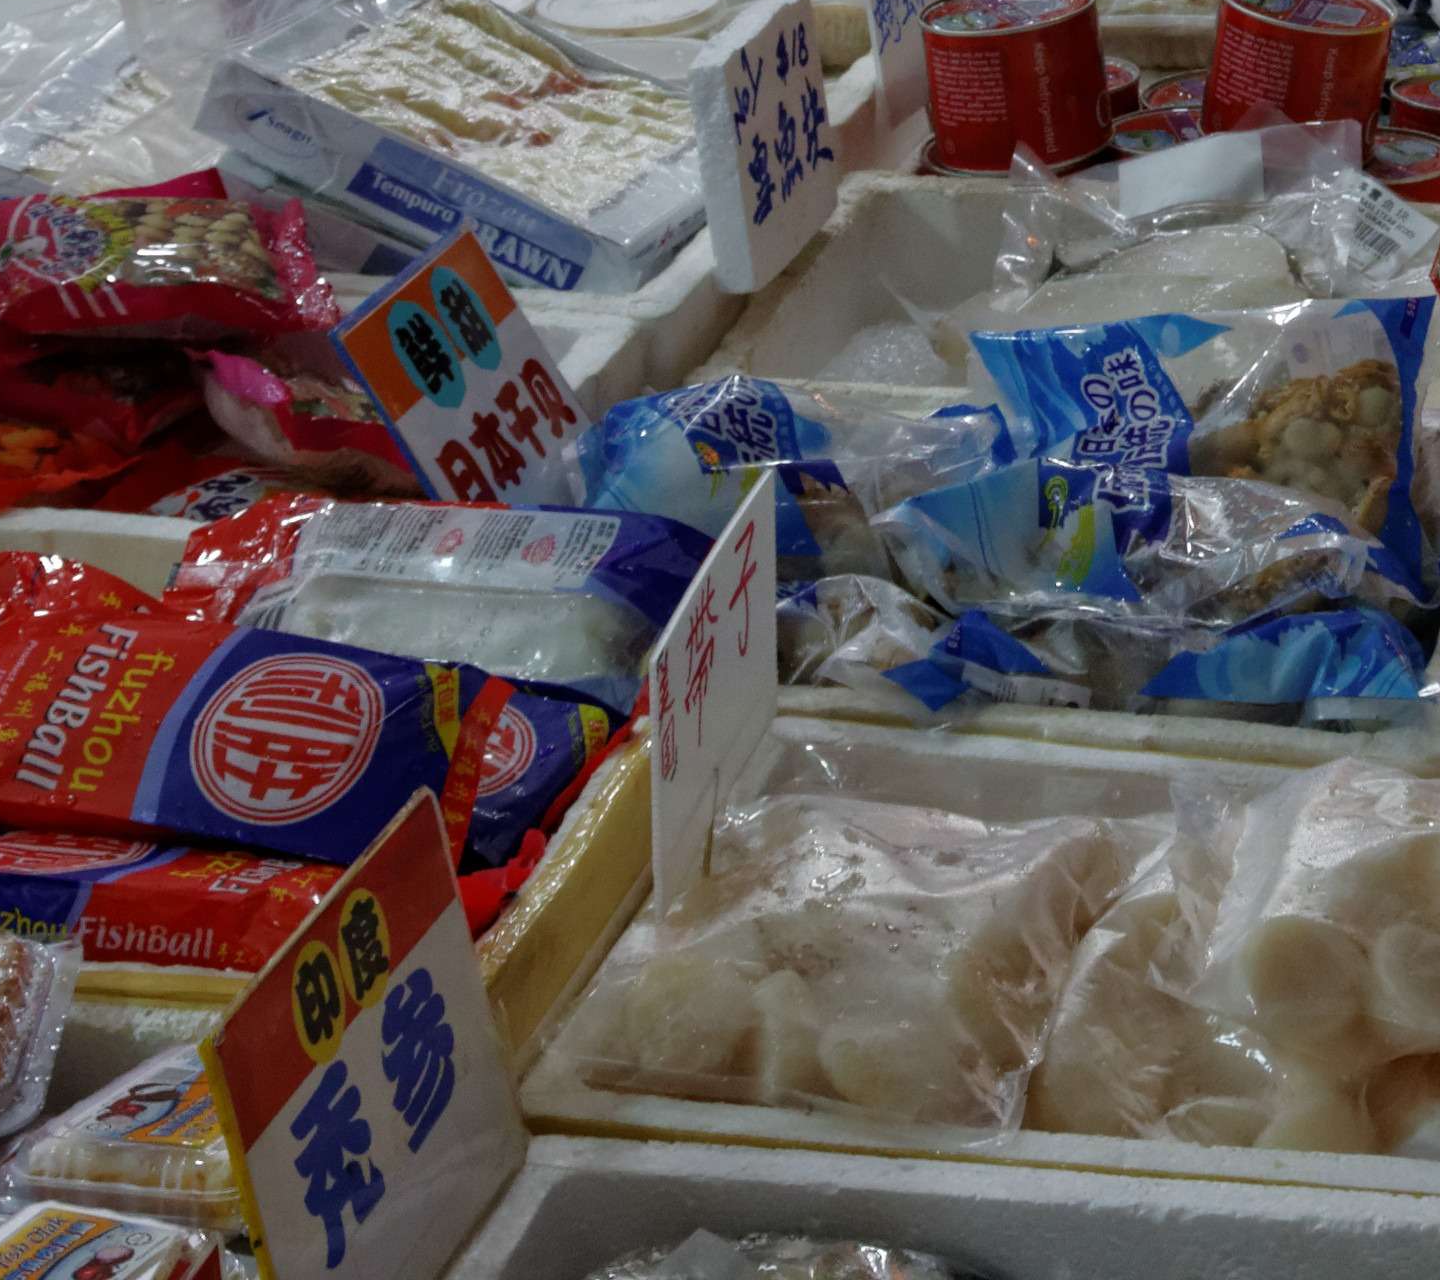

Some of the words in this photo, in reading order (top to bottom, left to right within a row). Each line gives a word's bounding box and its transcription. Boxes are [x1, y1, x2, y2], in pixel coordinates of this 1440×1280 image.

[369, 170, 458, 226] Tempura
[435, 358, 578, 502] 日本干贝
[14, 622, 141, 792] FishBall
[70, 648, 176, 793] fuzhou
[76, 917, 216, 961] FishBall
[296, 897, 391, 1046] 印度
